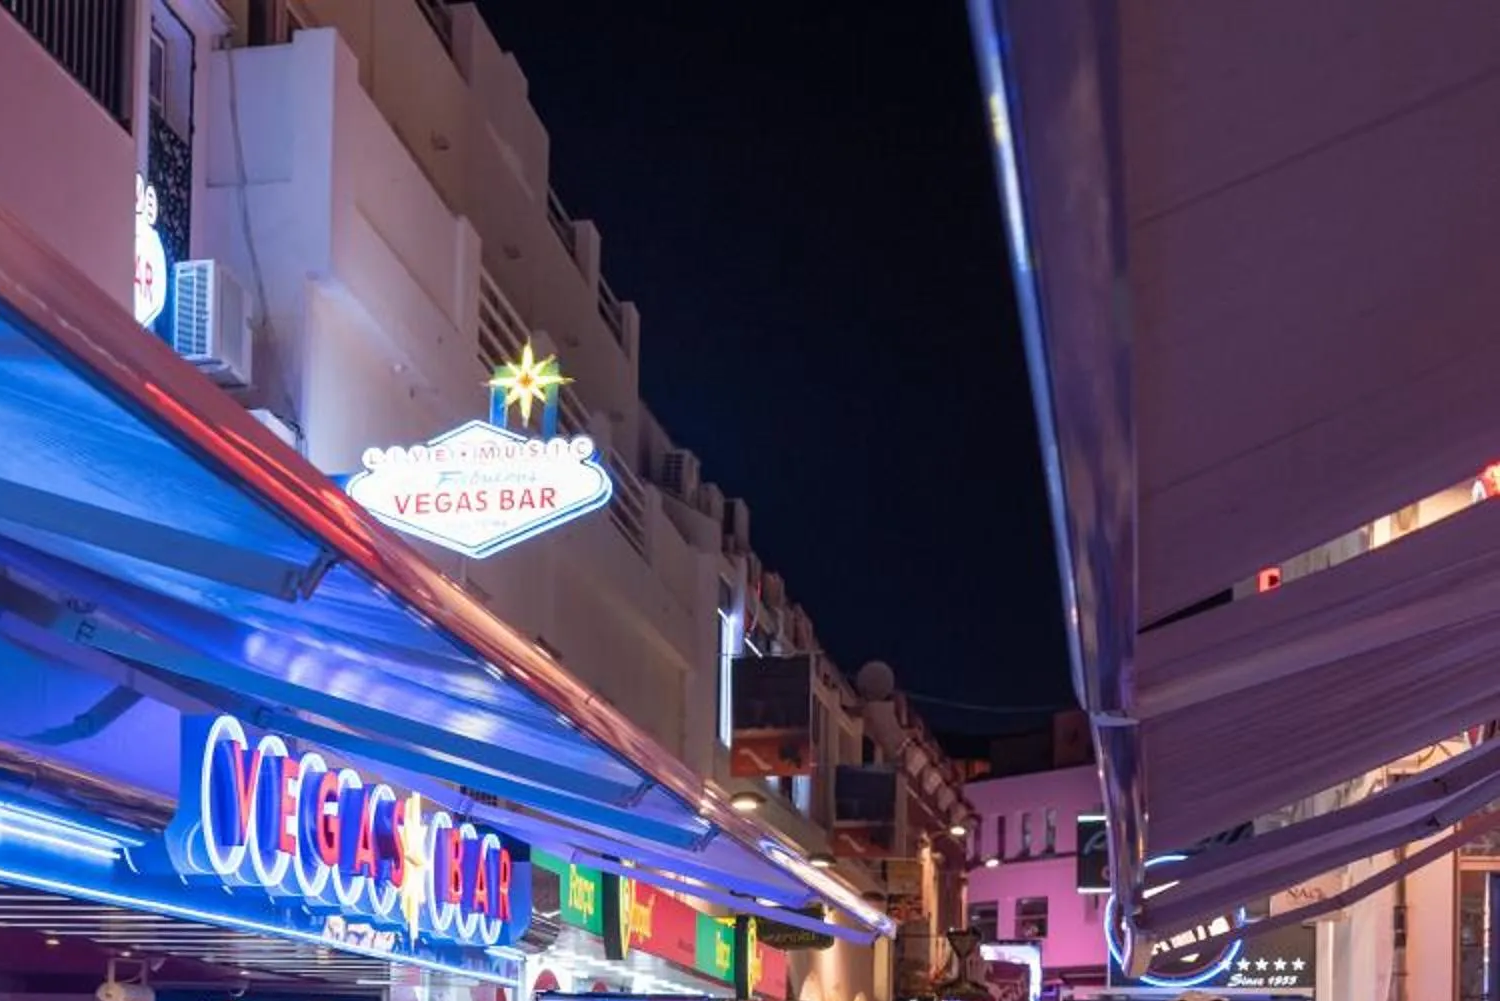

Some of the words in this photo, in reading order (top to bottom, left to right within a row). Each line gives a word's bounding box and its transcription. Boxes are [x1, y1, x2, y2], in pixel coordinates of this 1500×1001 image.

[394, 489, 489, 515] VEGAS
[499, 486, 558, 511] BAR
[232, 739, 406, 889] VEGAS
[448, 827, 513, 921] BAR
